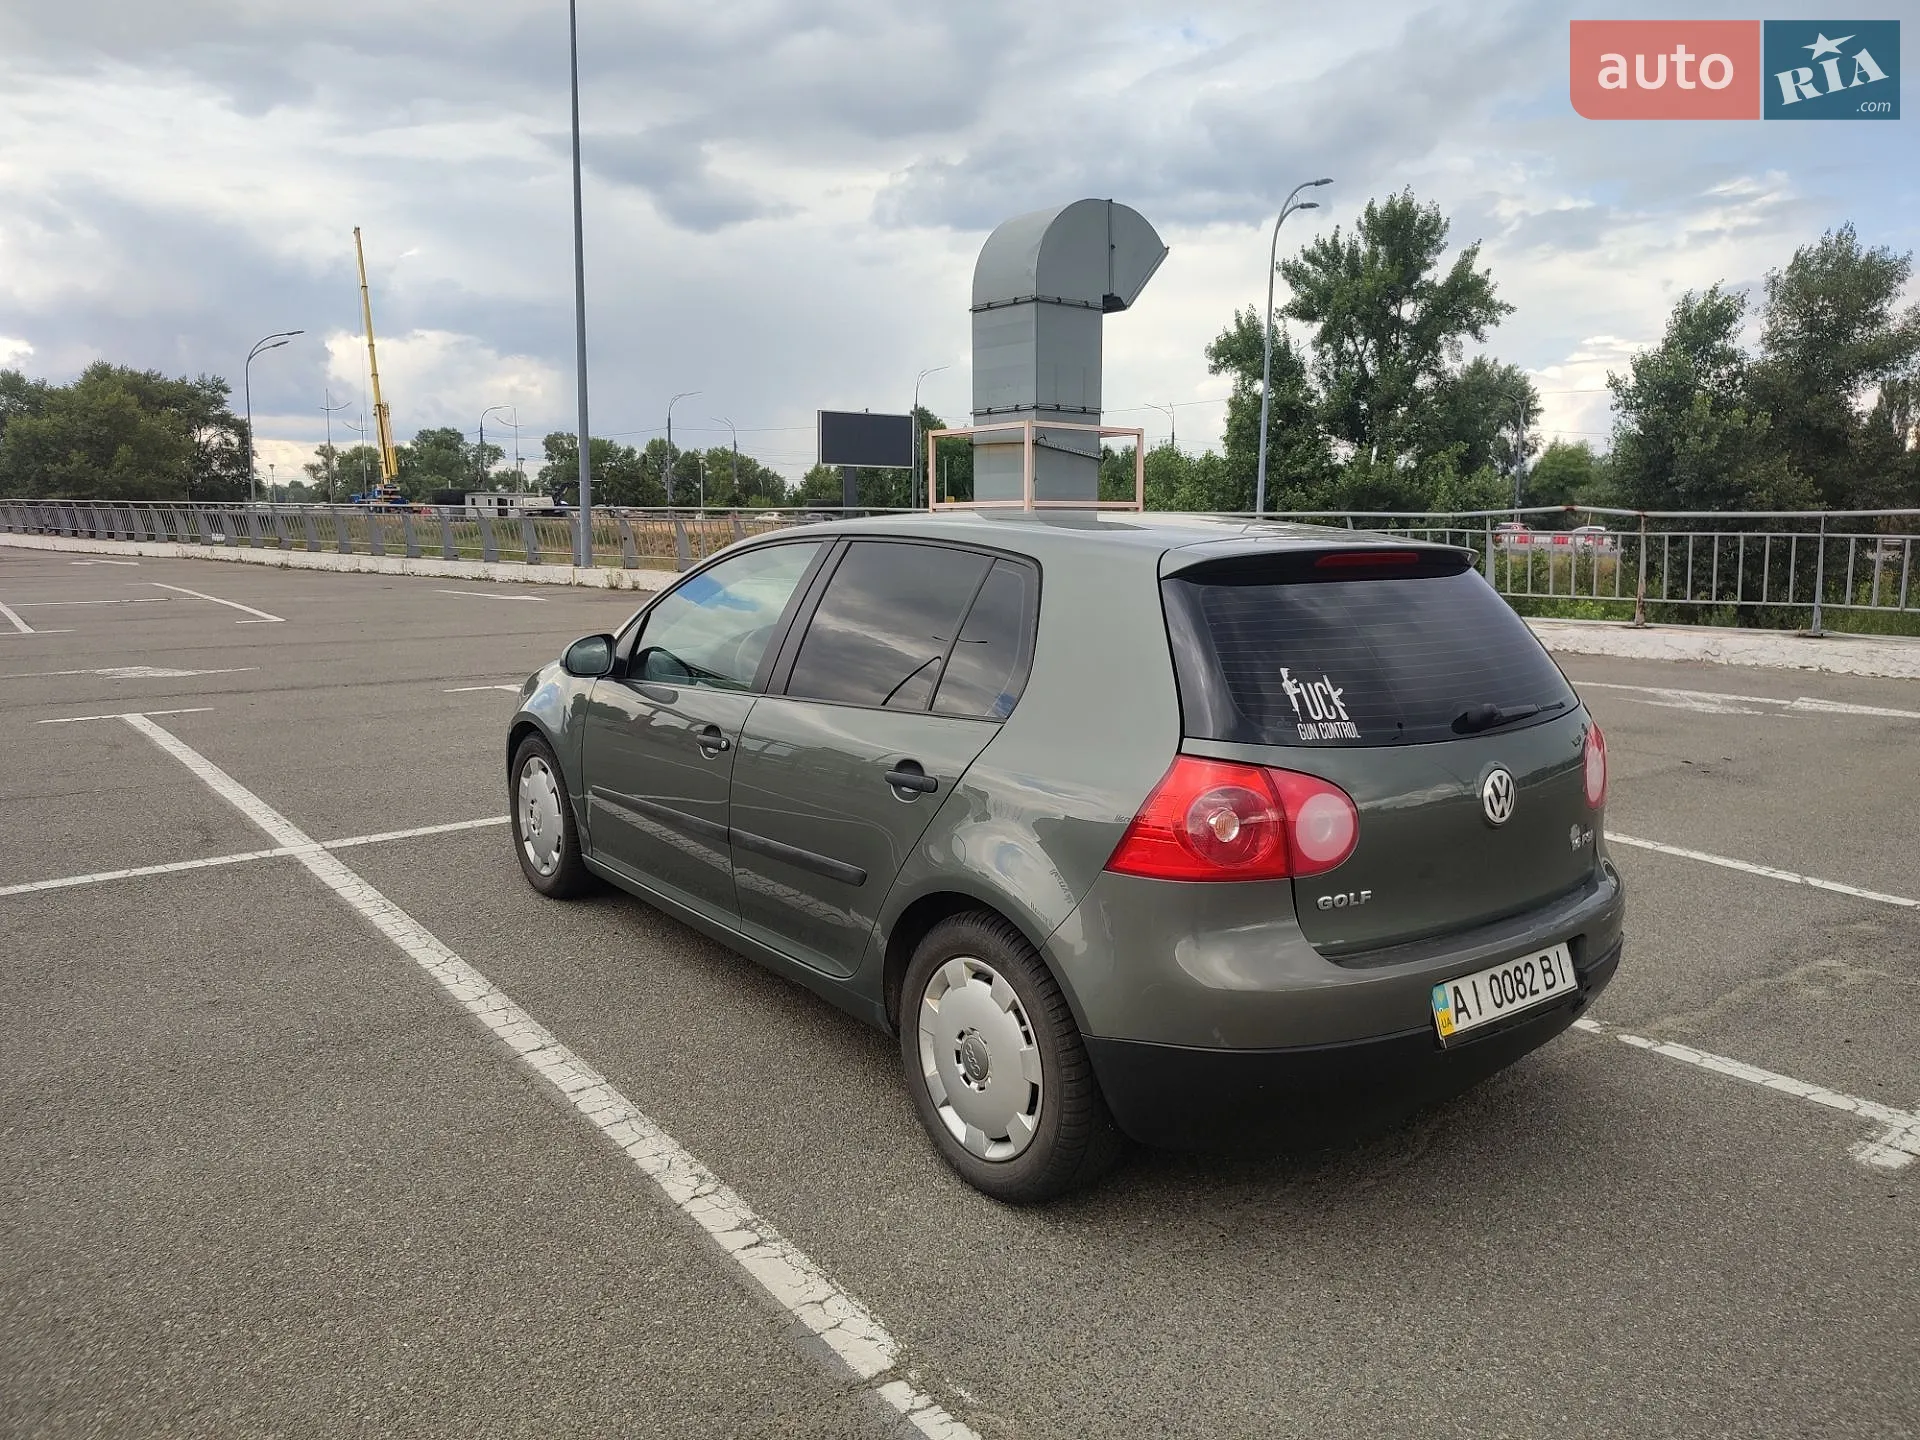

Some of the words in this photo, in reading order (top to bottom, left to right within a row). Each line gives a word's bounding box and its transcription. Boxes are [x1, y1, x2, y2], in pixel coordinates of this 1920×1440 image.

[1297, 723, 1320, 740] GUN
[1318, 722, 1361, 739] CONTROL
[1317, 890, 1372, 910] GOLF
[1453, 980, 1482, 1024] AI
[1489, 961, 1540, 1009] 0082
[1539, 950, 1566, 991] BI
